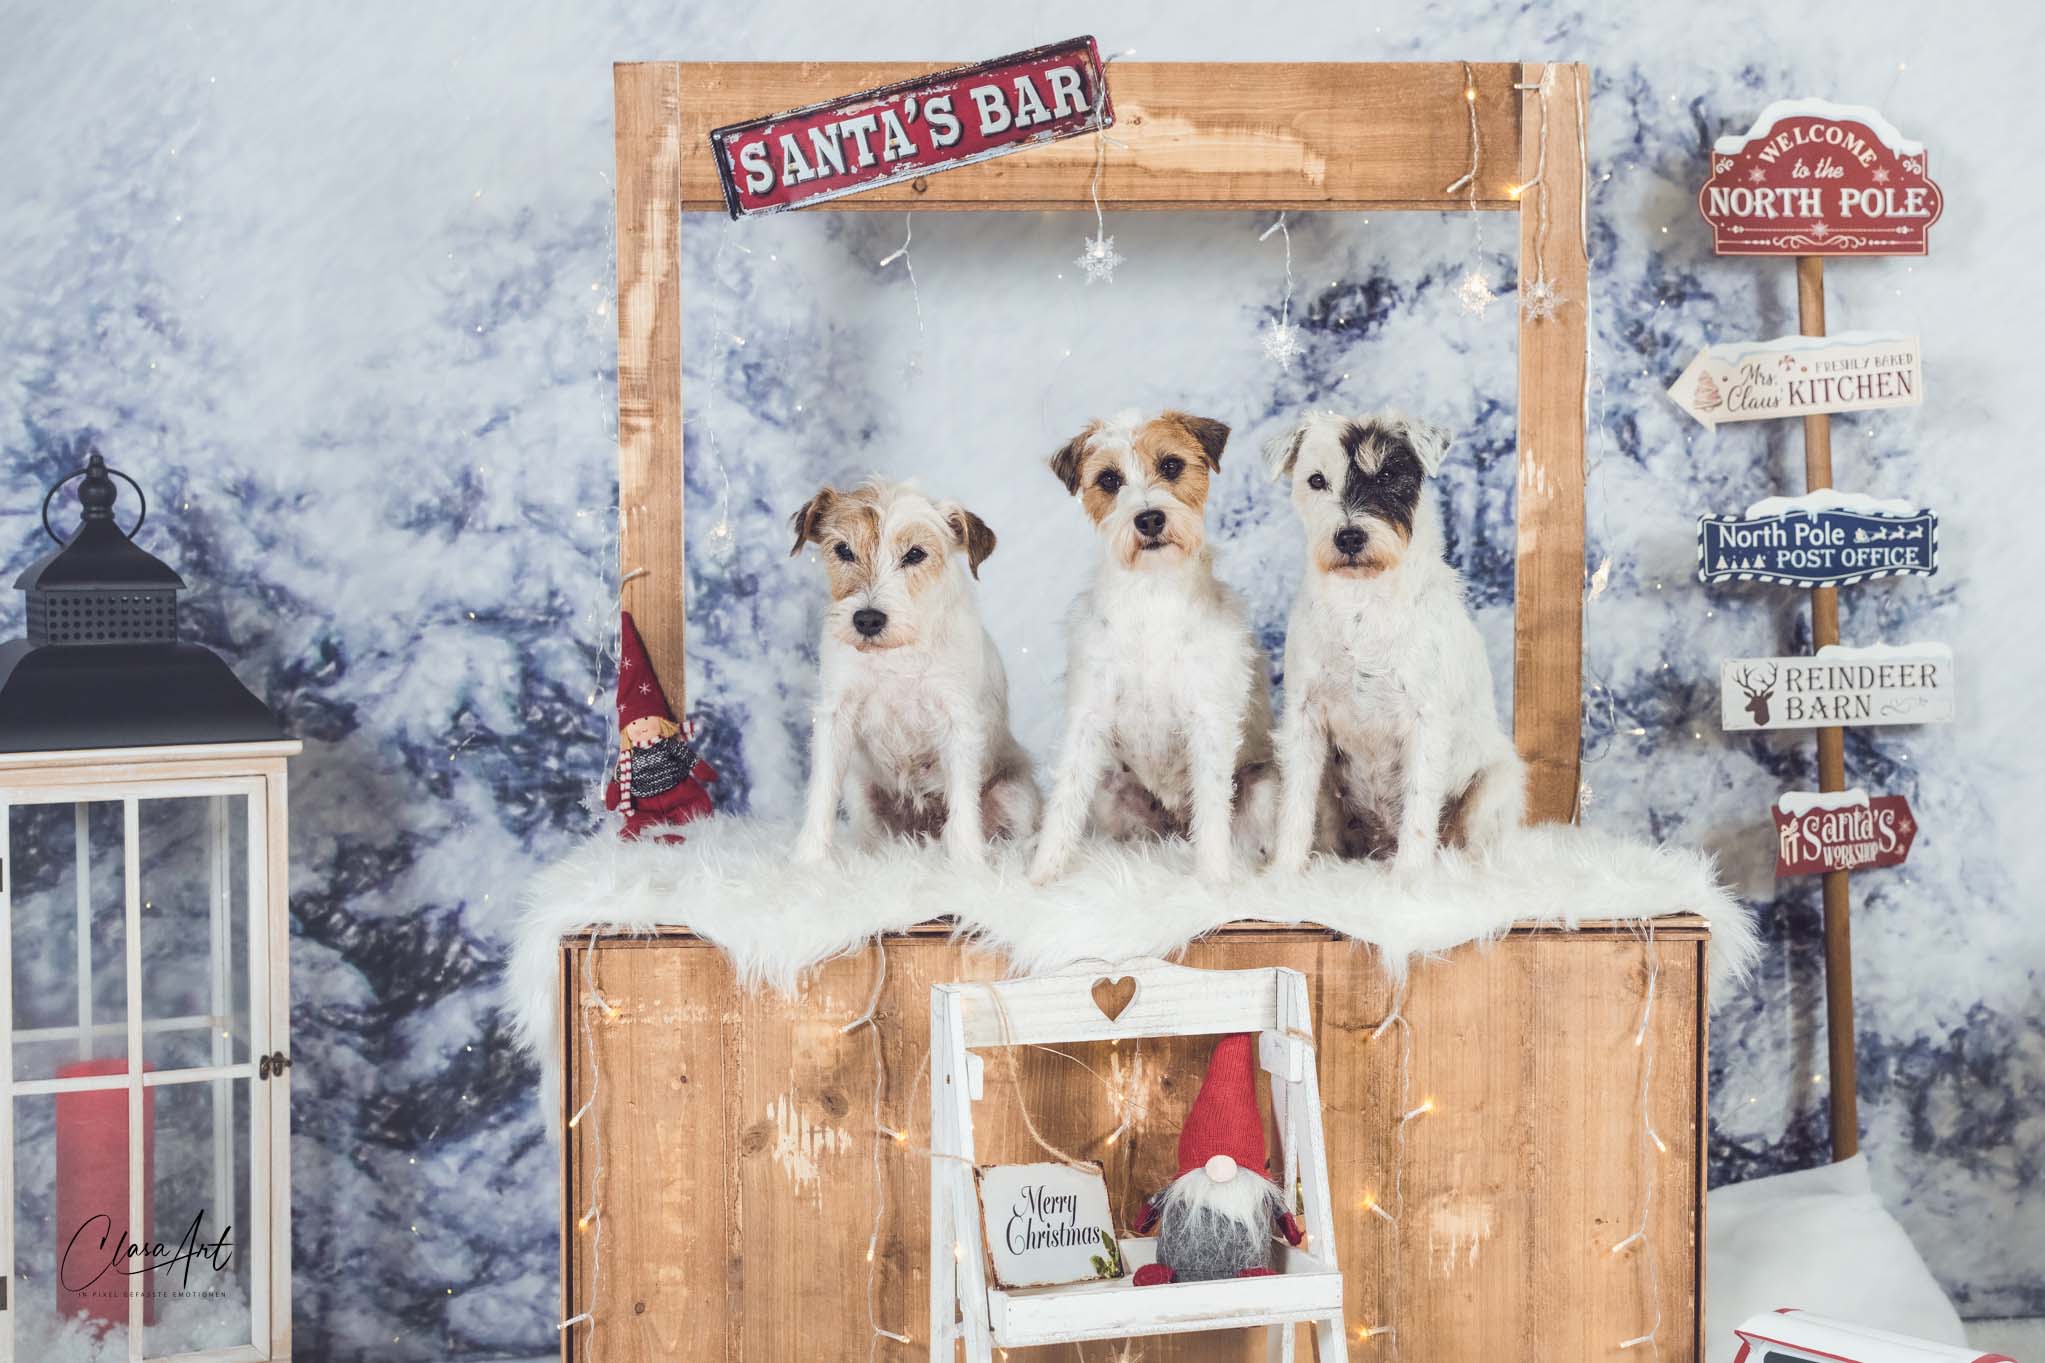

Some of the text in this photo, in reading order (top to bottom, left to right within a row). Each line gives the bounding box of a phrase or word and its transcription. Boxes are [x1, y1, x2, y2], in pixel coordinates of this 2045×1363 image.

[739, 65, 1091, 196] SANTA'S BAR
[1758, 124, 1878, 168] WELCOME
[1792, 156, 1844, 179] to the
[1708, 187, 1931, 219] NORTH POLE
[1815, 352, 1914, 373] FRESHLY BAKED
[1788, 370, 1913, 407] KITCHEN
[1718, 521, 1845, 549] North Pole
[1776, 546, 1919, 569] POST OFFICE
[1785, 664, 1937, 692] REINDEER
[1786, 695, 1872, 720] BARN
[1802, 807, 1896, 862] Santa's
[1823, 841, 1879, 869] WORKSHOP
[1013, 1184, 1077, 1228] Merry
[1006, 1213, 1101, 1256] Christmas
